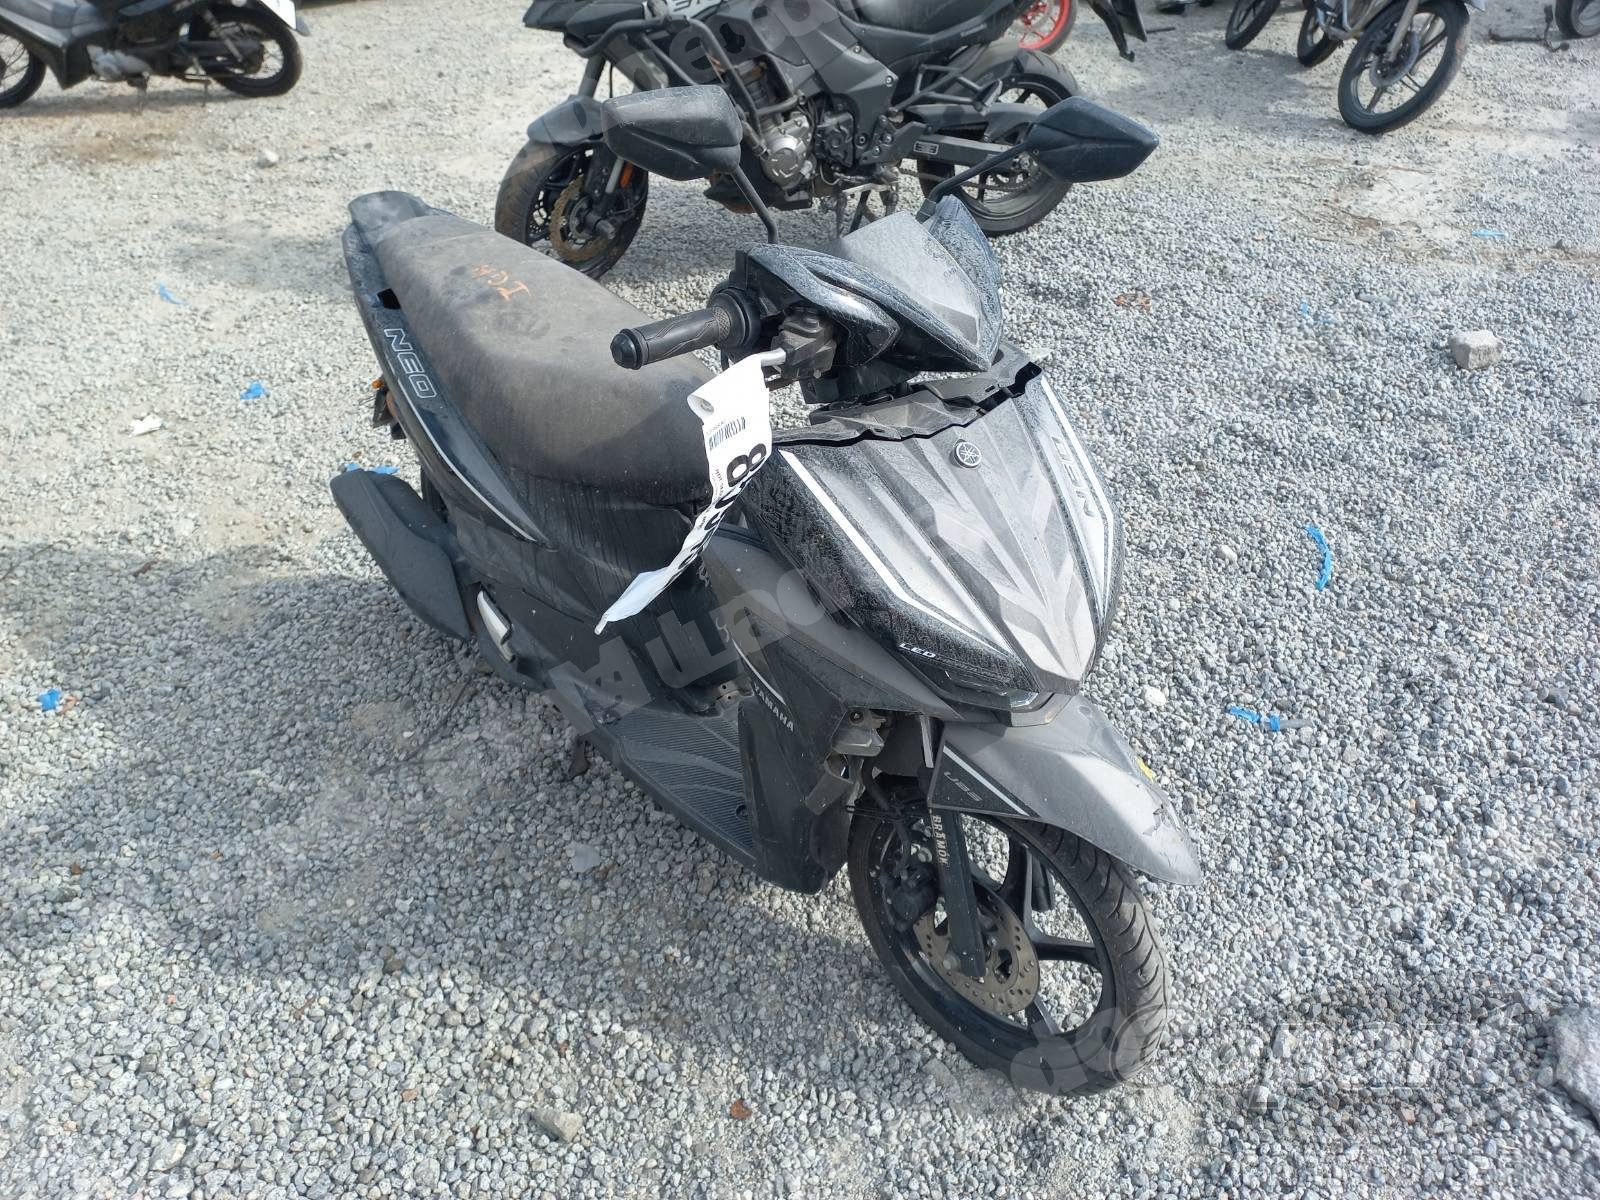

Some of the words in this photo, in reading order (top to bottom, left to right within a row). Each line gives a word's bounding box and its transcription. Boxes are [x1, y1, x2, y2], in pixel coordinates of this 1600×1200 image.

[383, 328, 437, 399] NEO
[1051, 436, 1097, 518] NEO
[898, 643, 936, 658] LED
[753, 683, 795, 731] YAMAHA
